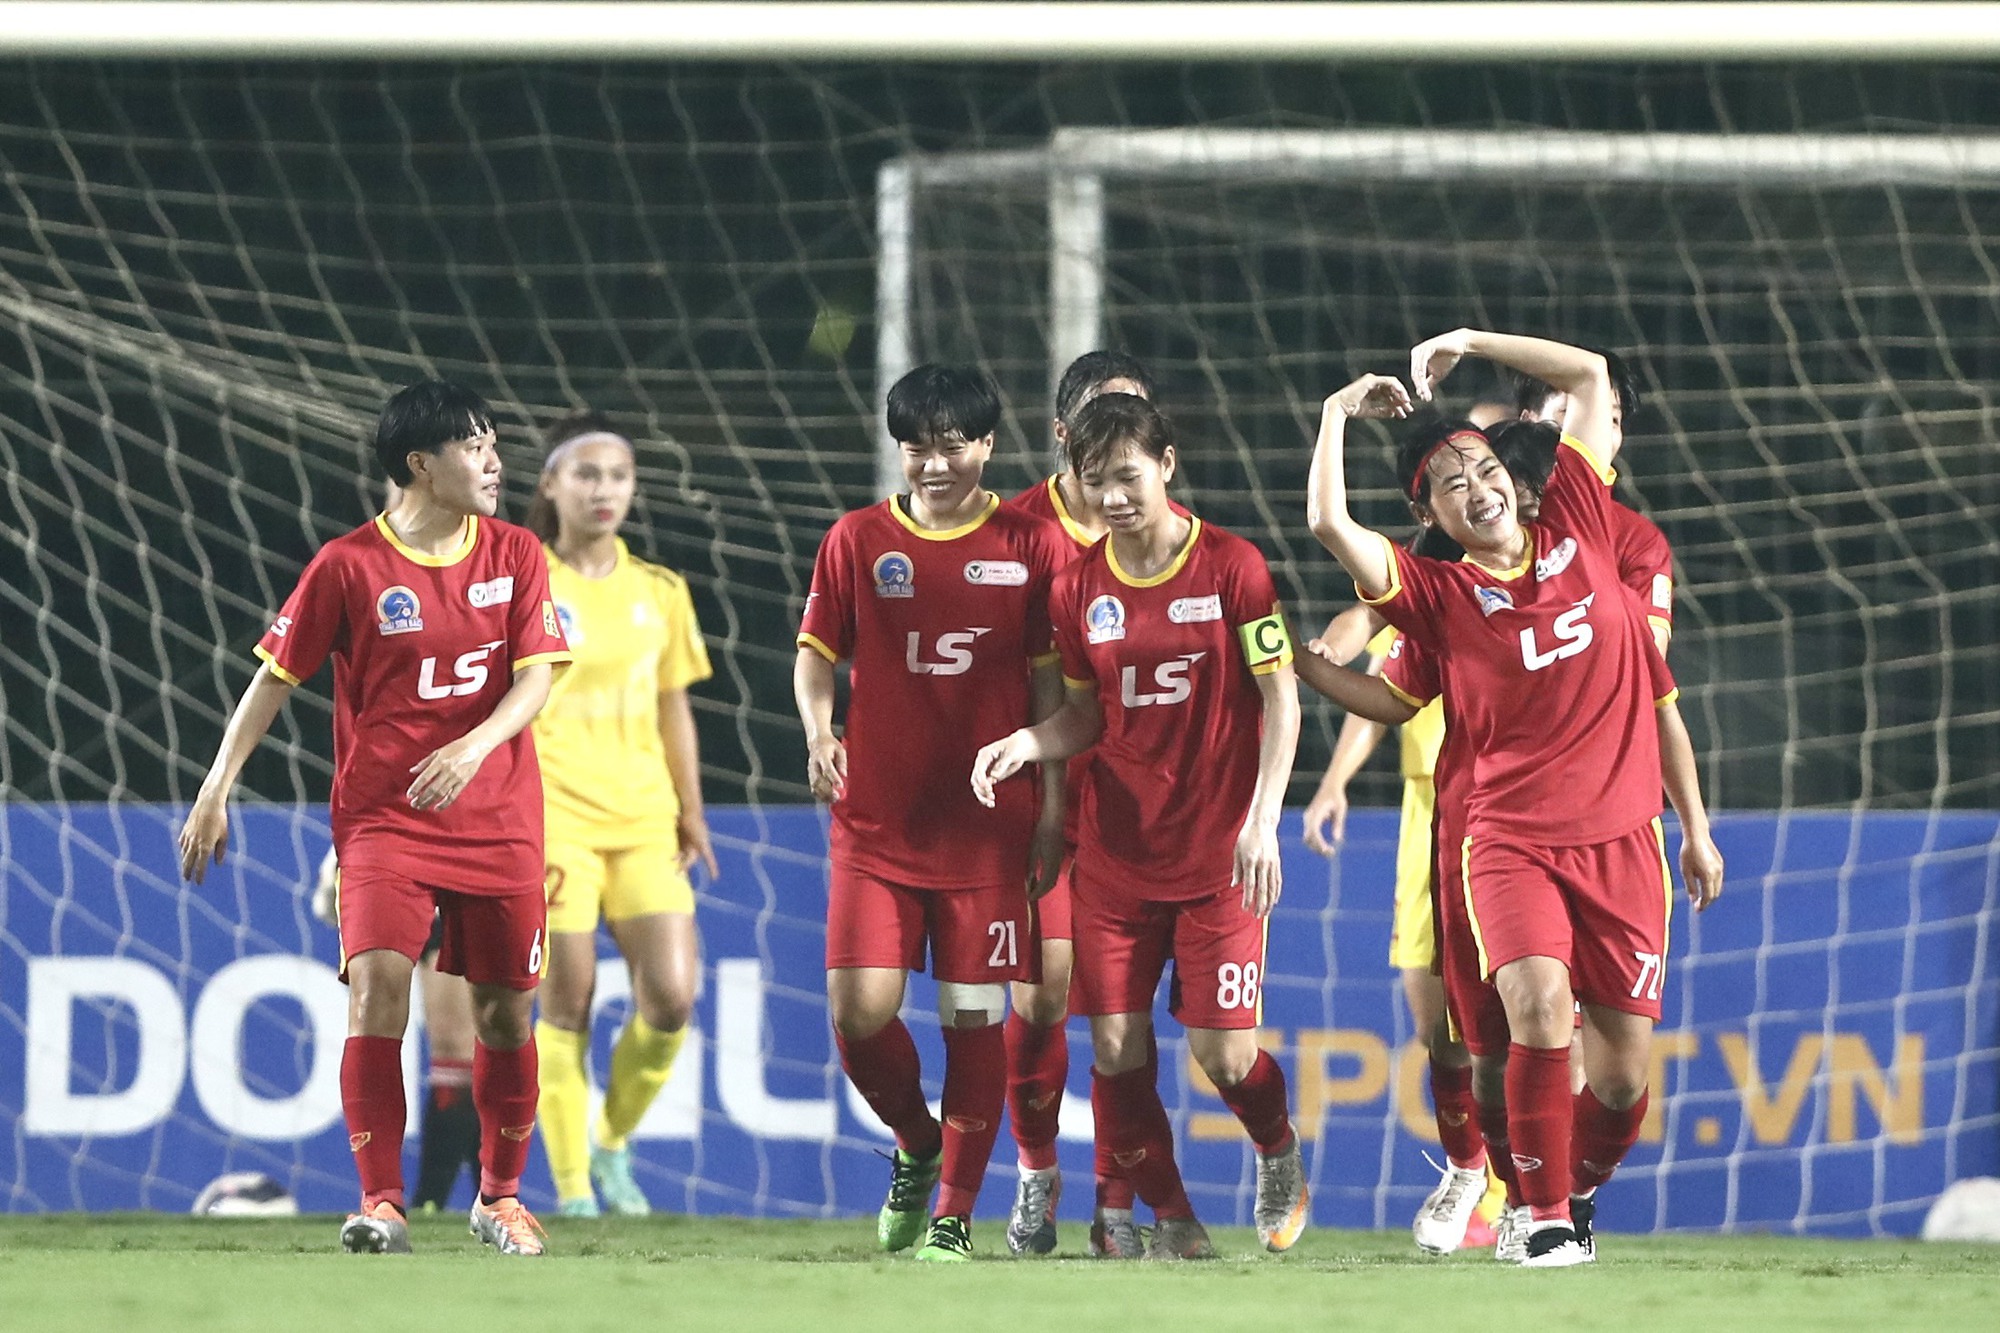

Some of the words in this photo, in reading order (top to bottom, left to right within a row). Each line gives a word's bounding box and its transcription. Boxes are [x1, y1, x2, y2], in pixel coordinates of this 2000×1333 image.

[906, 631, 975, 676] LS
[1254, 619, 1284, 654] C
[1519, 605, 1594, 672] LS
[417, 648, 489, 700] LS
[1121, 659, 1192, 708] LS
[528, 928, 542, 975] 6
[988, 920, 1017, 967] 21
[1217, 961, 1259, 1010] 88
[1630, 951, 1661, 1000] 72
